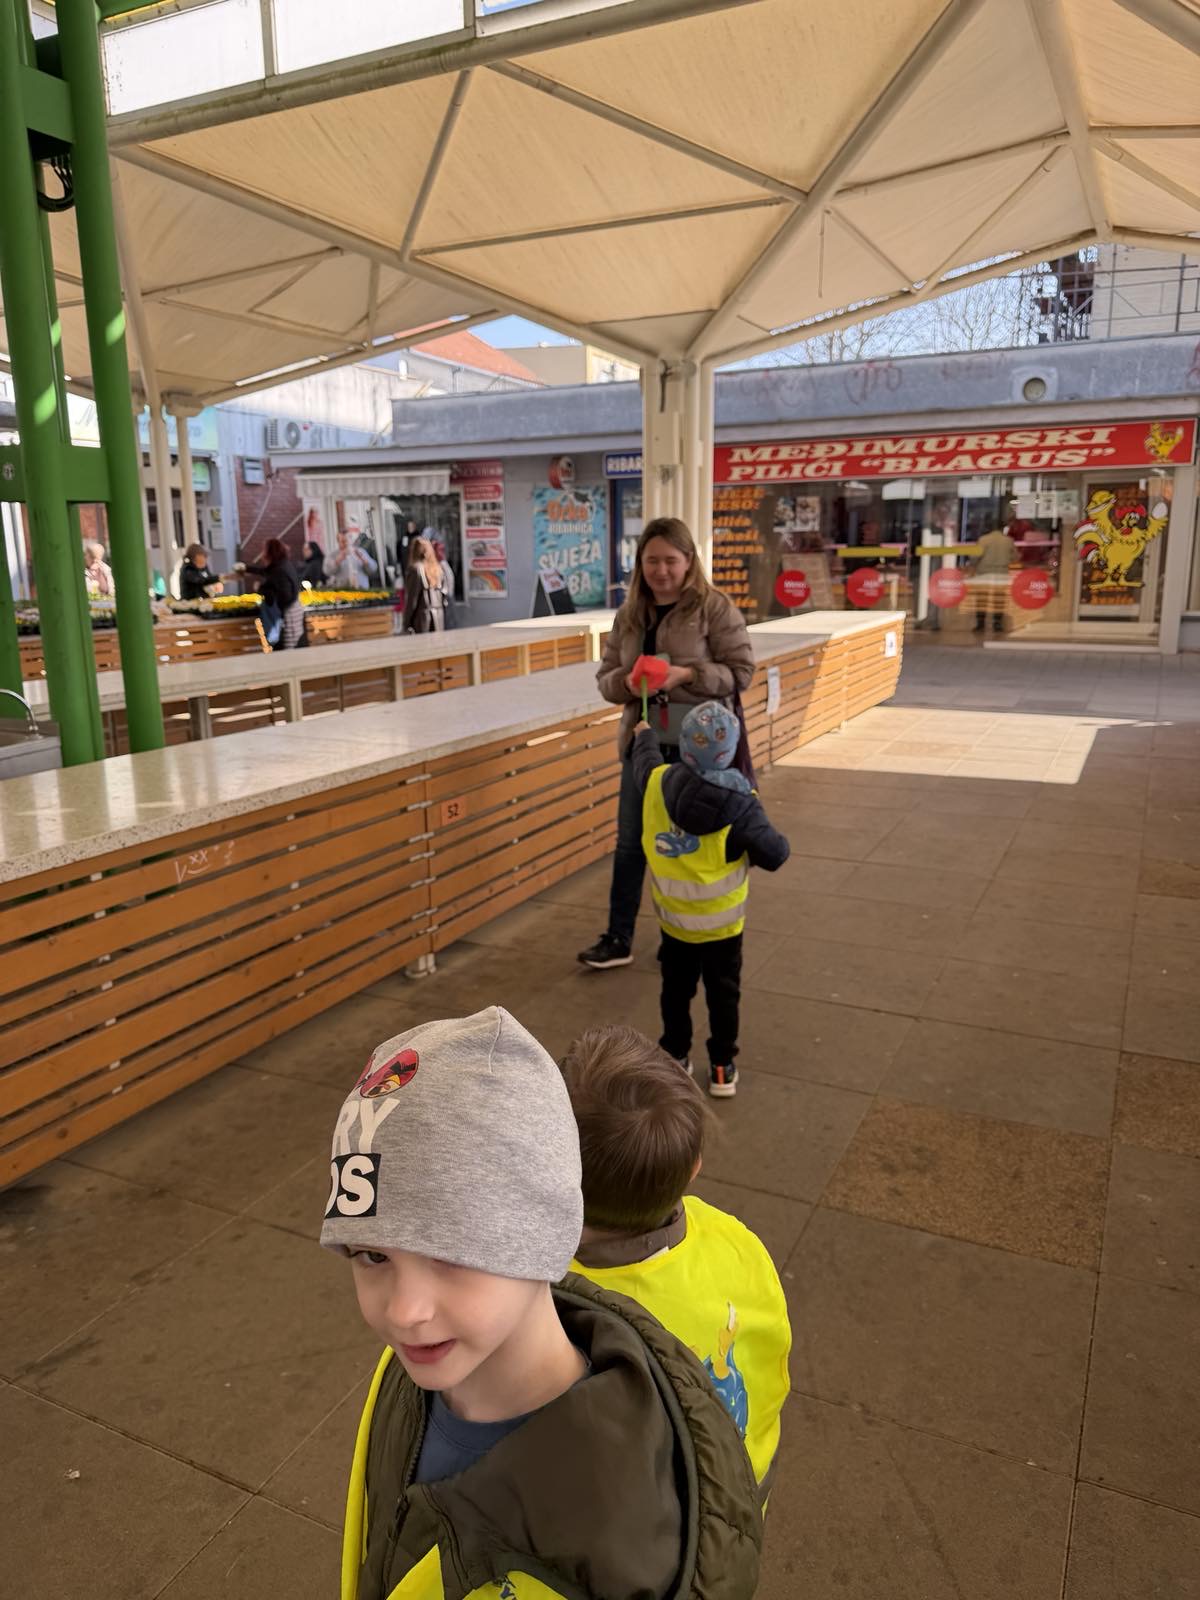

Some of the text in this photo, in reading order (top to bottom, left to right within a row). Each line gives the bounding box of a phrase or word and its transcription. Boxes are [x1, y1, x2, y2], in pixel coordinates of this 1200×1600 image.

[728, 428, 1117, 463] MEĐIMURSKI
[607, 456, 643, 472] RIBAR
[727, 457, 846, 481] PILIĆI
[331, 1098, 401, 1160] RY
